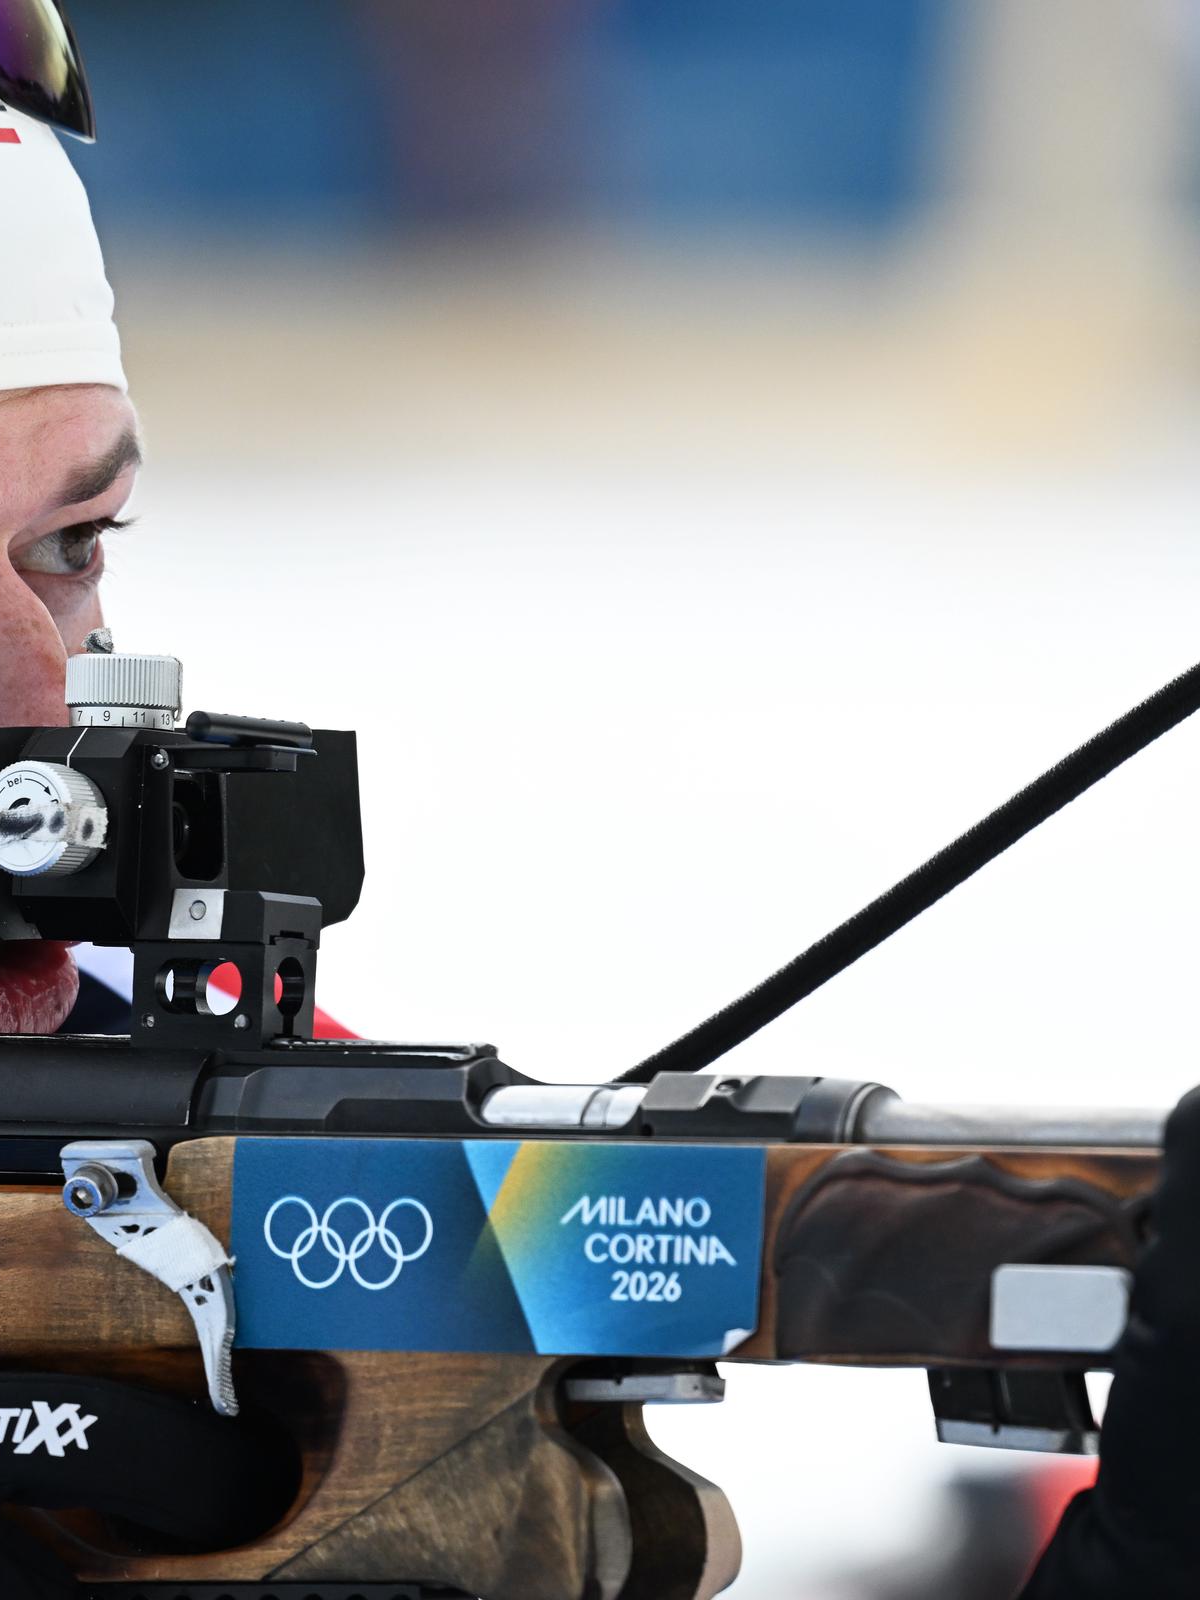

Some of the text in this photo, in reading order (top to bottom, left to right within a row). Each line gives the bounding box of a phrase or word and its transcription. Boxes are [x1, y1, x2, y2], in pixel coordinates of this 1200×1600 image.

[77, 710, 170, 725] 7 9 11 13
[6, 775, 23, 788] bei
[559, 1195, 712, 1228] MILANO
[584, 1232, 738, 1267] CORTINA
[609, 1270, 682, 1303] 2026
